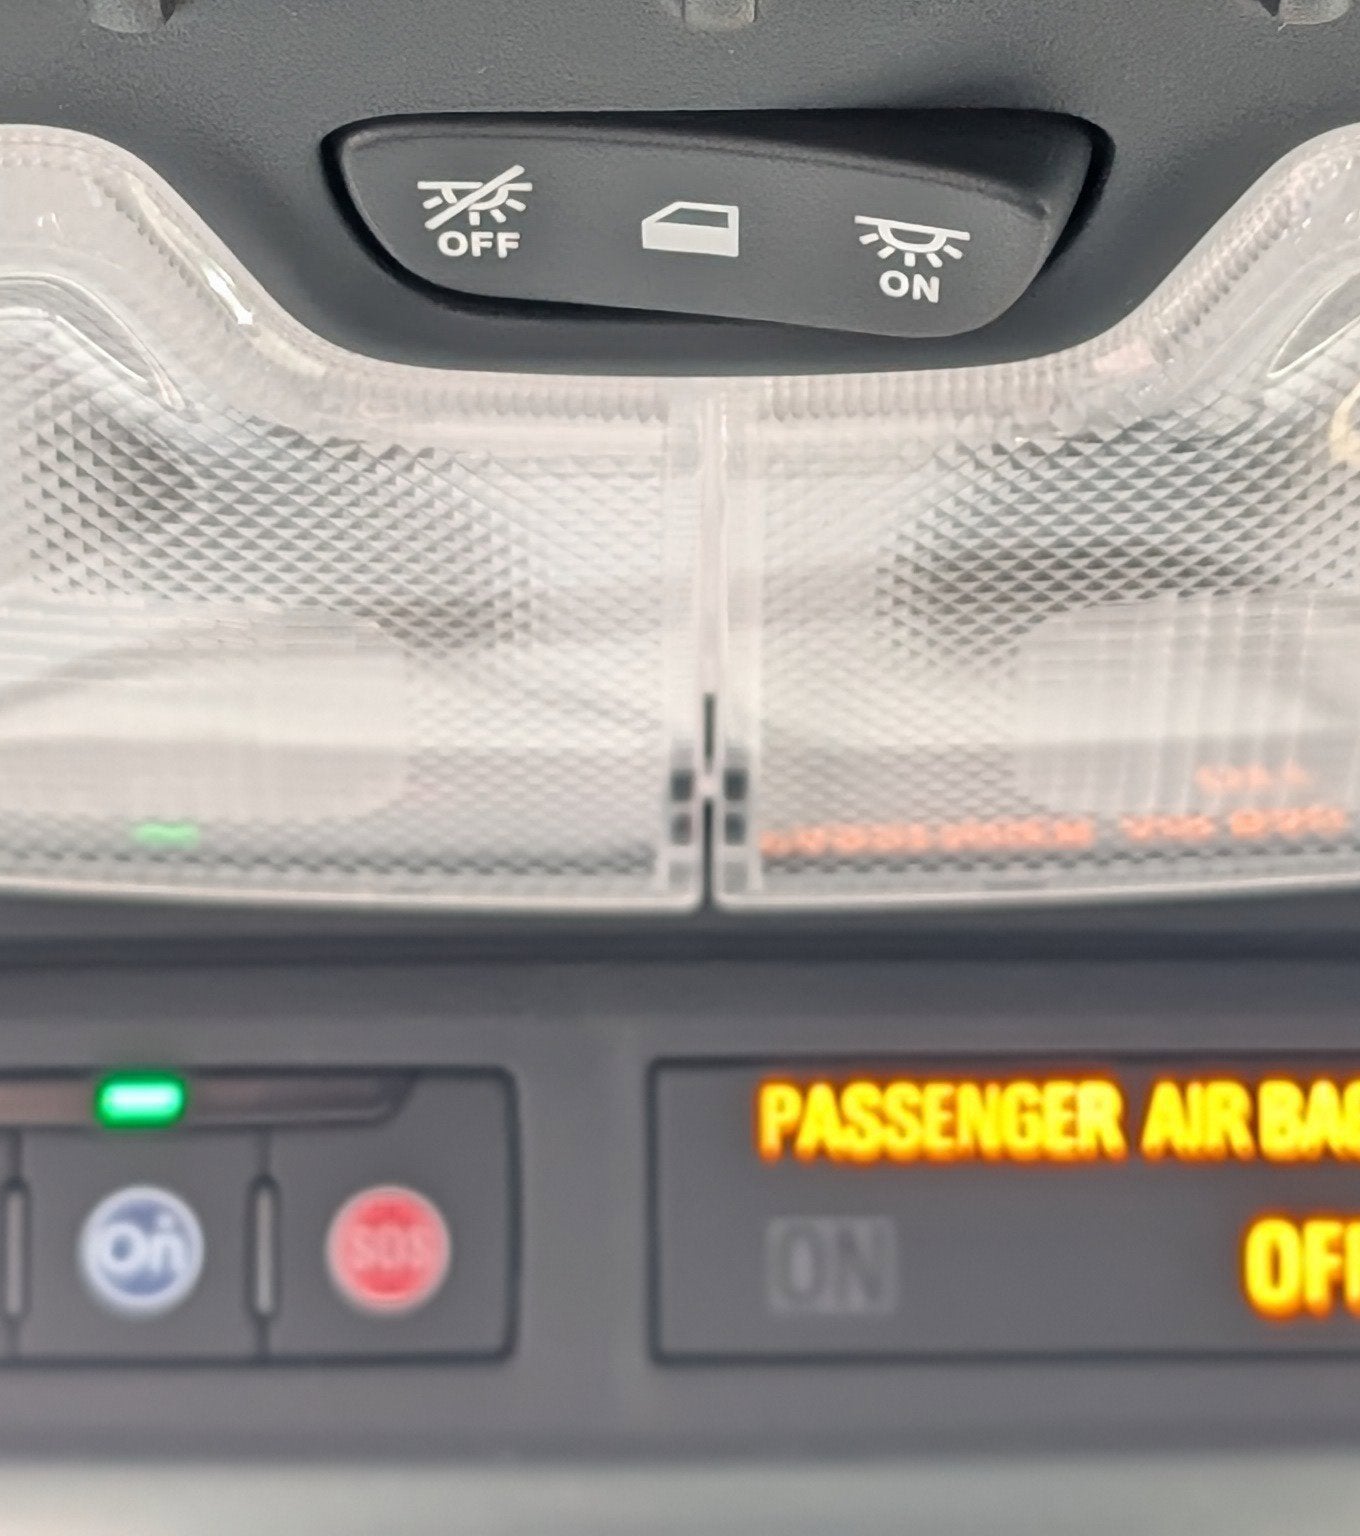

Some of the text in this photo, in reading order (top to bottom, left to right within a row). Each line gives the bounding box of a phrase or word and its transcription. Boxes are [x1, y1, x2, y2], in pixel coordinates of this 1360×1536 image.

[436, 229, 521, 259] OFF
[877, 269, 940, 305] ON
[756, 1076, 1128, 1163] PASSENGER
[1140, 1075, 1256, 1162] AIR
[772, 1220, 892, 1311] ON
